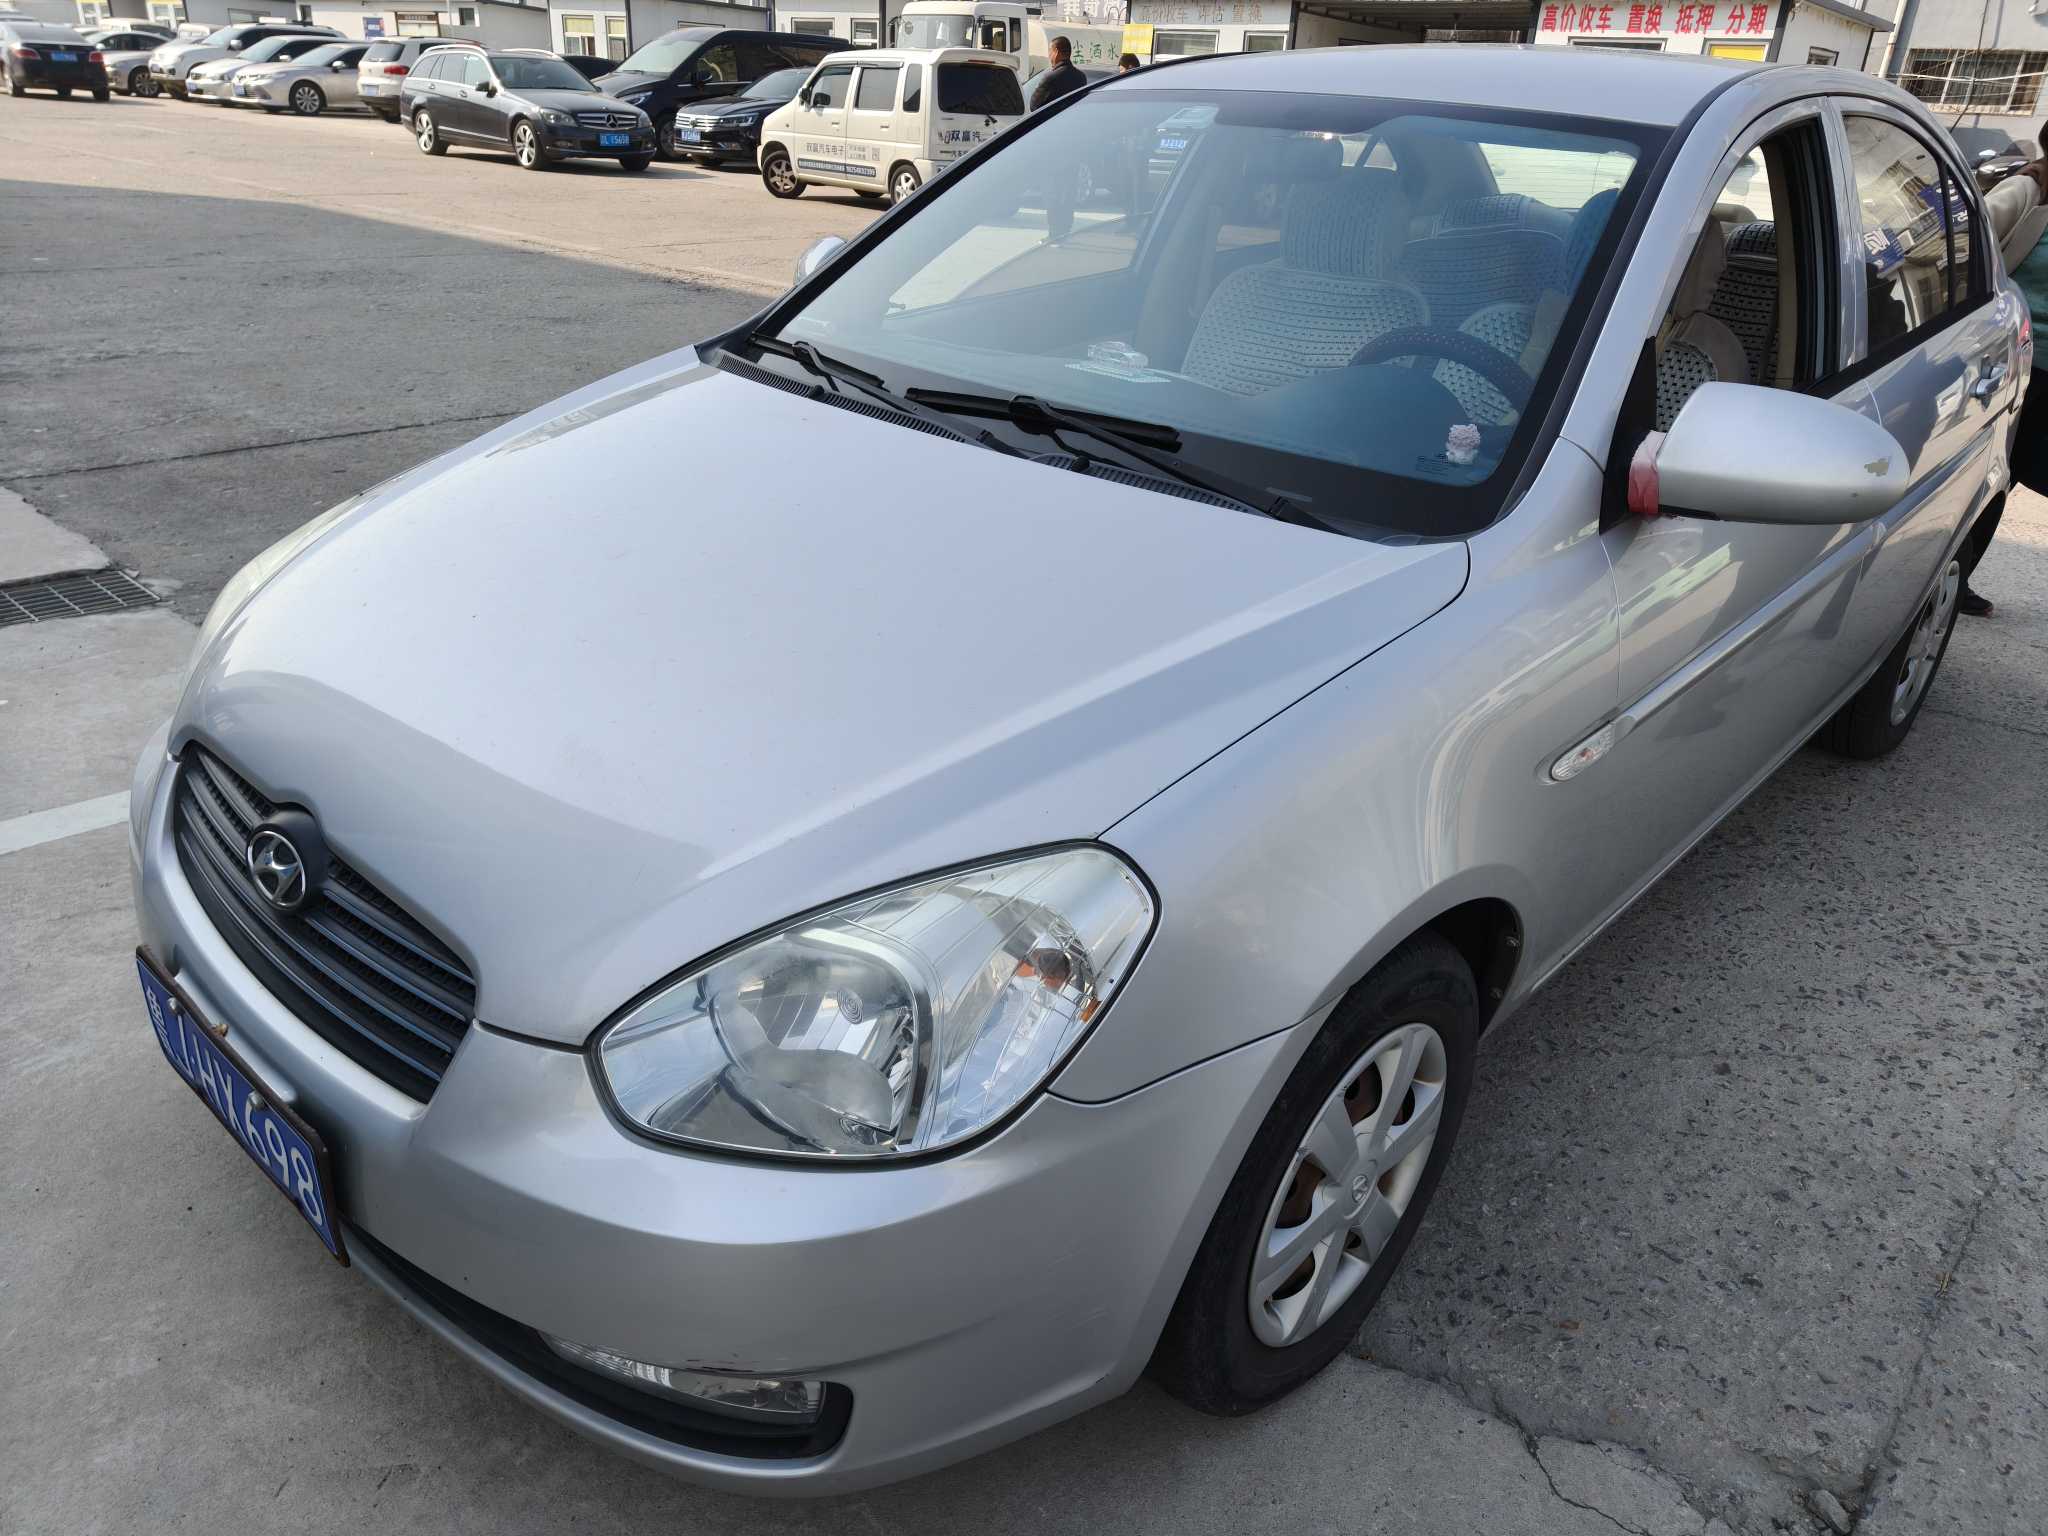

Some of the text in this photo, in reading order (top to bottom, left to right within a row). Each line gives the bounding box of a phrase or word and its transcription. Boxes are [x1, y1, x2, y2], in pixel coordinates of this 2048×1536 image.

[1541, 3, 1769, 35] 高价收车 置换 抵押 分期
